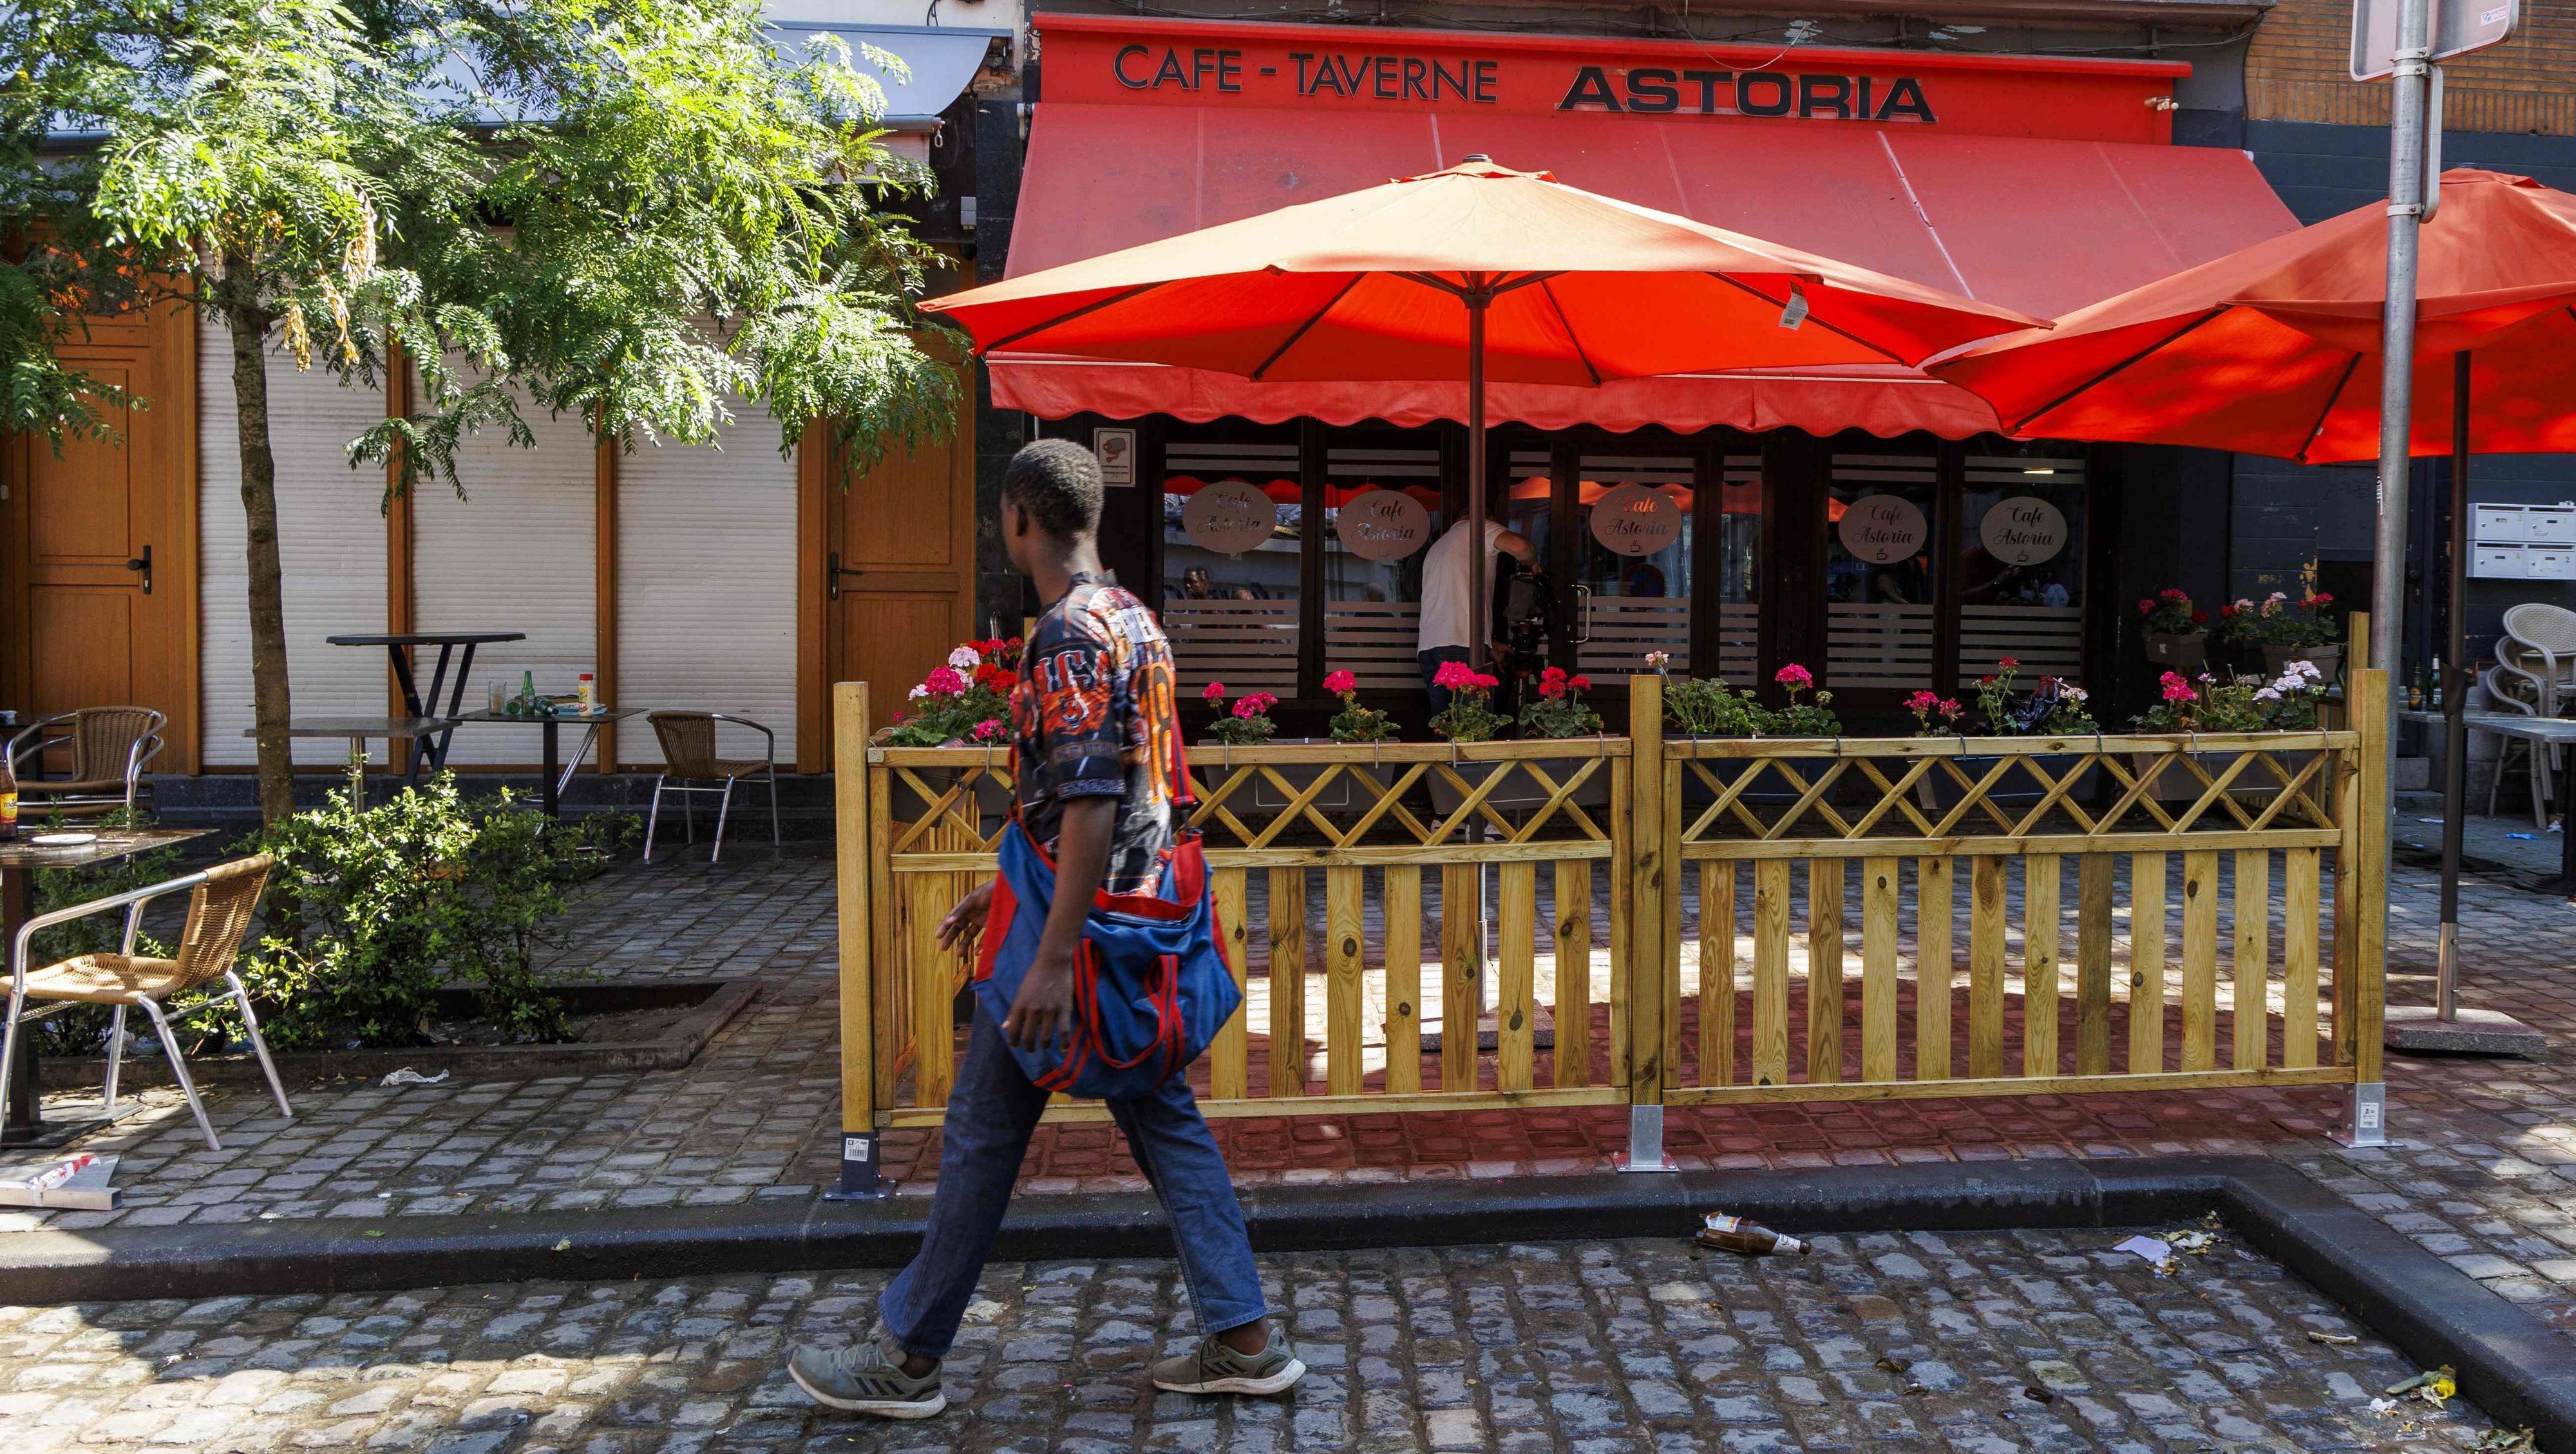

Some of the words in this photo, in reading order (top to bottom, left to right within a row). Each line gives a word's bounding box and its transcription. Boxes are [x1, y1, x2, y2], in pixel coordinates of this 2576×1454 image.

[1113, 44, 1242, 92] CAFE
[1259, 66, 1278, 75] -
[1289, 53, 1498, 103] TAVERNE
[1557, 66, 1937, 123] ASTORIA
[1210, 490, 1253, 514] Cafe
[1363, 500, 1406, 522] Cafe
[1616, 495, 1659, 518] Cafe
[1864, 504, 1906, 526] Cafe
[2006, 506, 2045, 528] Cafe
[1350, 522, 1416, 542] Astoria
[1604, 518, 1668, 536] Astoria
[1852, 525, 1914, 544] Astoria
[1993, 527, 2054, 546] Astoria
